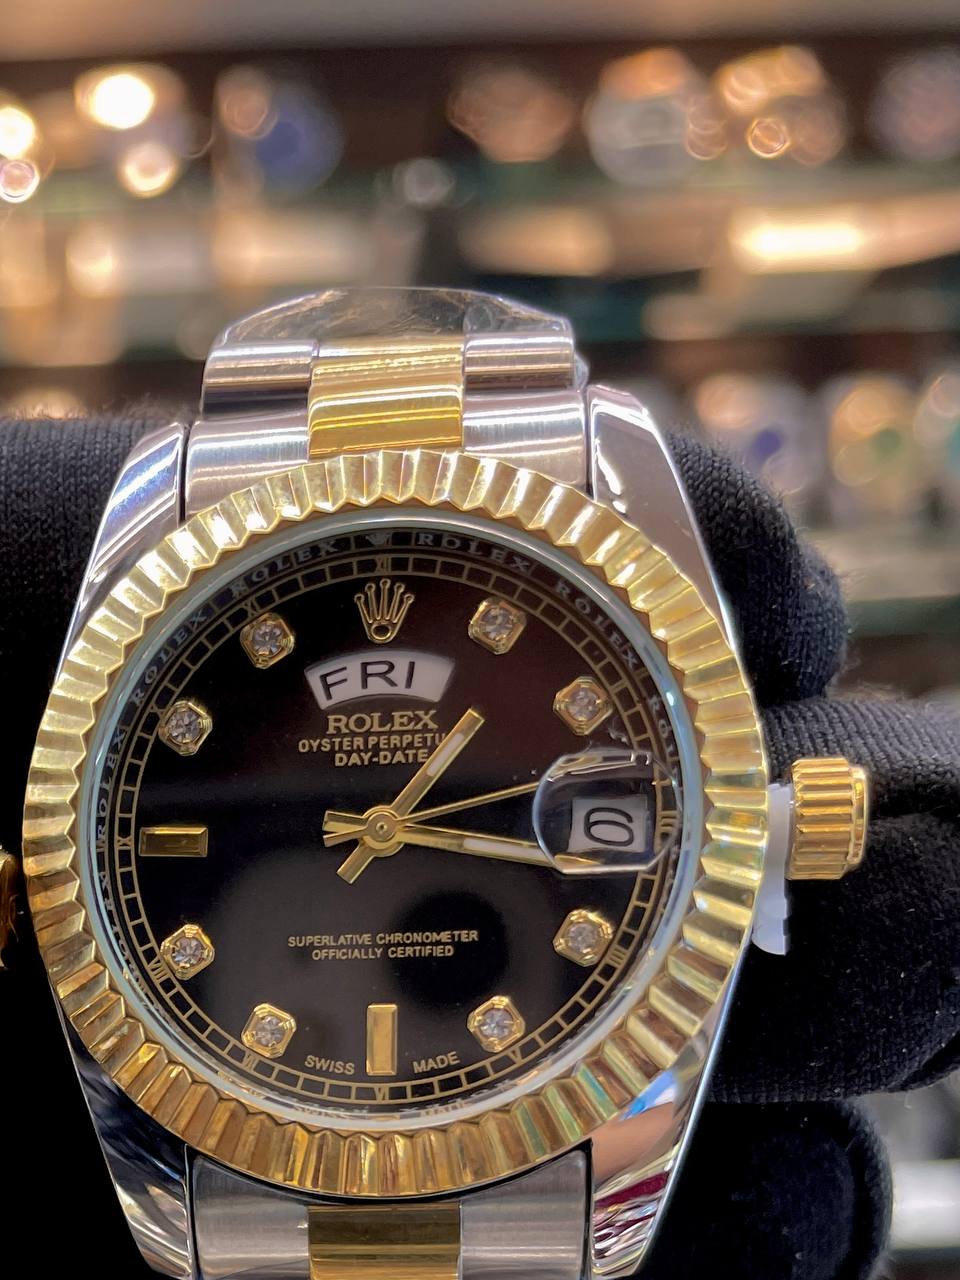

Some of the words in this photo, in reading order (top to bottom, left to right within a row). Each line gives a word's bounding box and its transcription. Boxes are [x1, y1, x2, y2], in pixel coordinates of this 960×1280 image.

[416, 532, 531, 571] ROLEX
[319, 660, 416, 701] FRI
[326, 710, 439, 735] ROLEX
[298, 736, 364, 753] OYSTER
[334, 750, 429, 767] DAY-DATE
[584, 807, 634, 847] 6
[288, 933, 373, 947] SUPERLATIVE
[376, 930, 479, 945] CHRONOMETER
[312, 947, 383, 961] OFFICIALLY
[387, 945, 455, 958] CERTIFIED
[304, 1054, 356, 1075] SWISS
[412, 1051, 461, 1074] MADE
